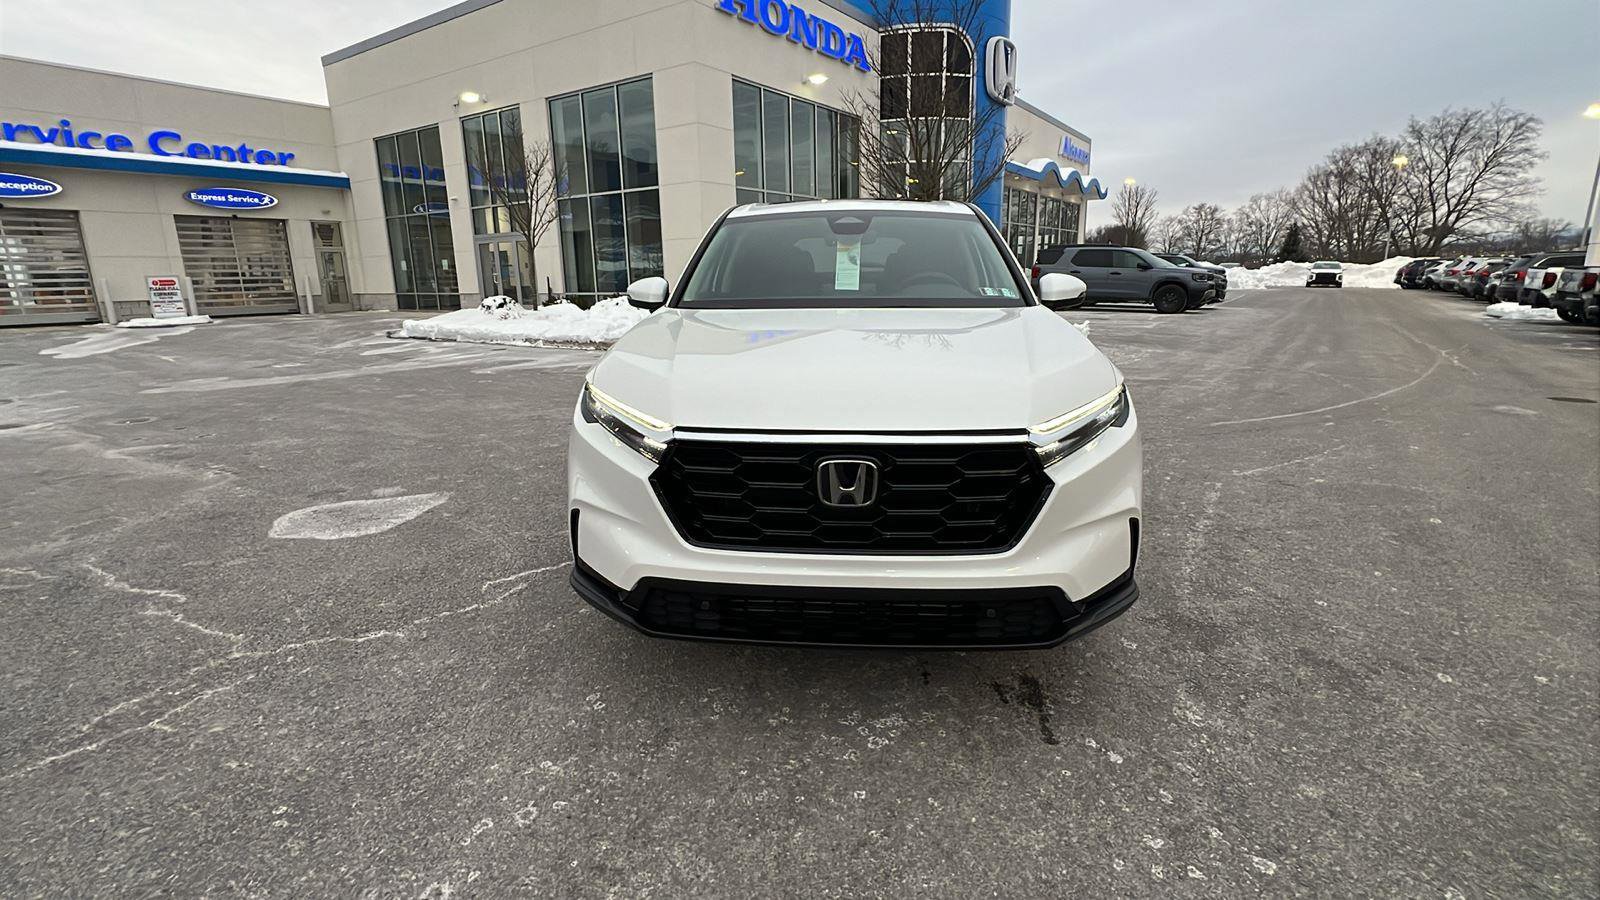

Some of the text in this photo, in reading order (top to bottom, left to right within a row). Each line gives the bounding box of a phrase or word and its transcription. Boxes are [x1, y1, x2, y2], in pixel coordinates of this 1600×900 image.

[1, 119, 295, 166] rvice Center
[190, 192, 259, 204] Express Service
